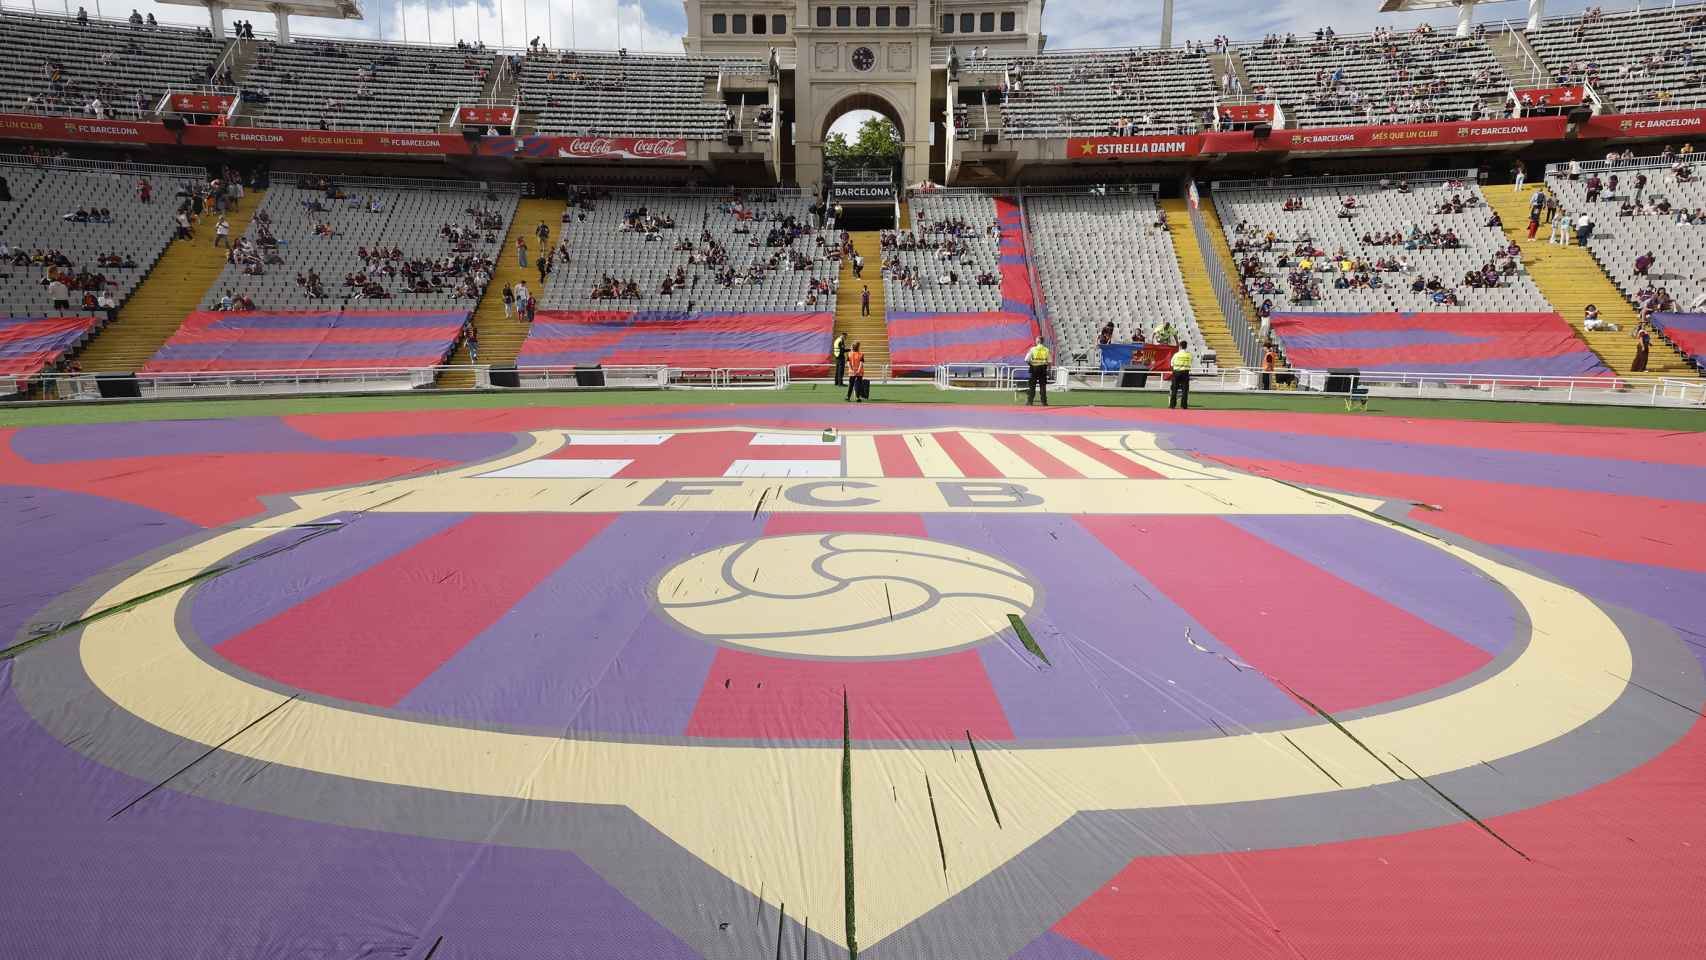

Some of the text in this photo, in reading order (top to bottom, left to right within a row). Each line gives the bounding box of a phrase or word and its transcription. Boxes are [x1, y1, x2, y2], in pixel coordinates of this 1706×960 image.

[20, 121, 43, 130] CLUB
[1635, 118, 1700, 129] FC BARCELONA
[79, 125, 138, 135] FC BARCELONA
[1481, 126, 1528, 135] BARCELONA
[241, 134, 284, 142] BARCELONA
[1312, 134, 1355, 143] BARCELONA
[1389, 131, 1405, 140] QUE
[1418, 130, 1440, 138] CLUB
[319, 137, 332, 145] QUE
[345, 137, 364, 145] CLUB
[401, 139, 440, 147] BARCELONA
[1097, 141, 1186, 155] ESTRELLA DAMM
[835, 187, 890, 196] BARCELONA
